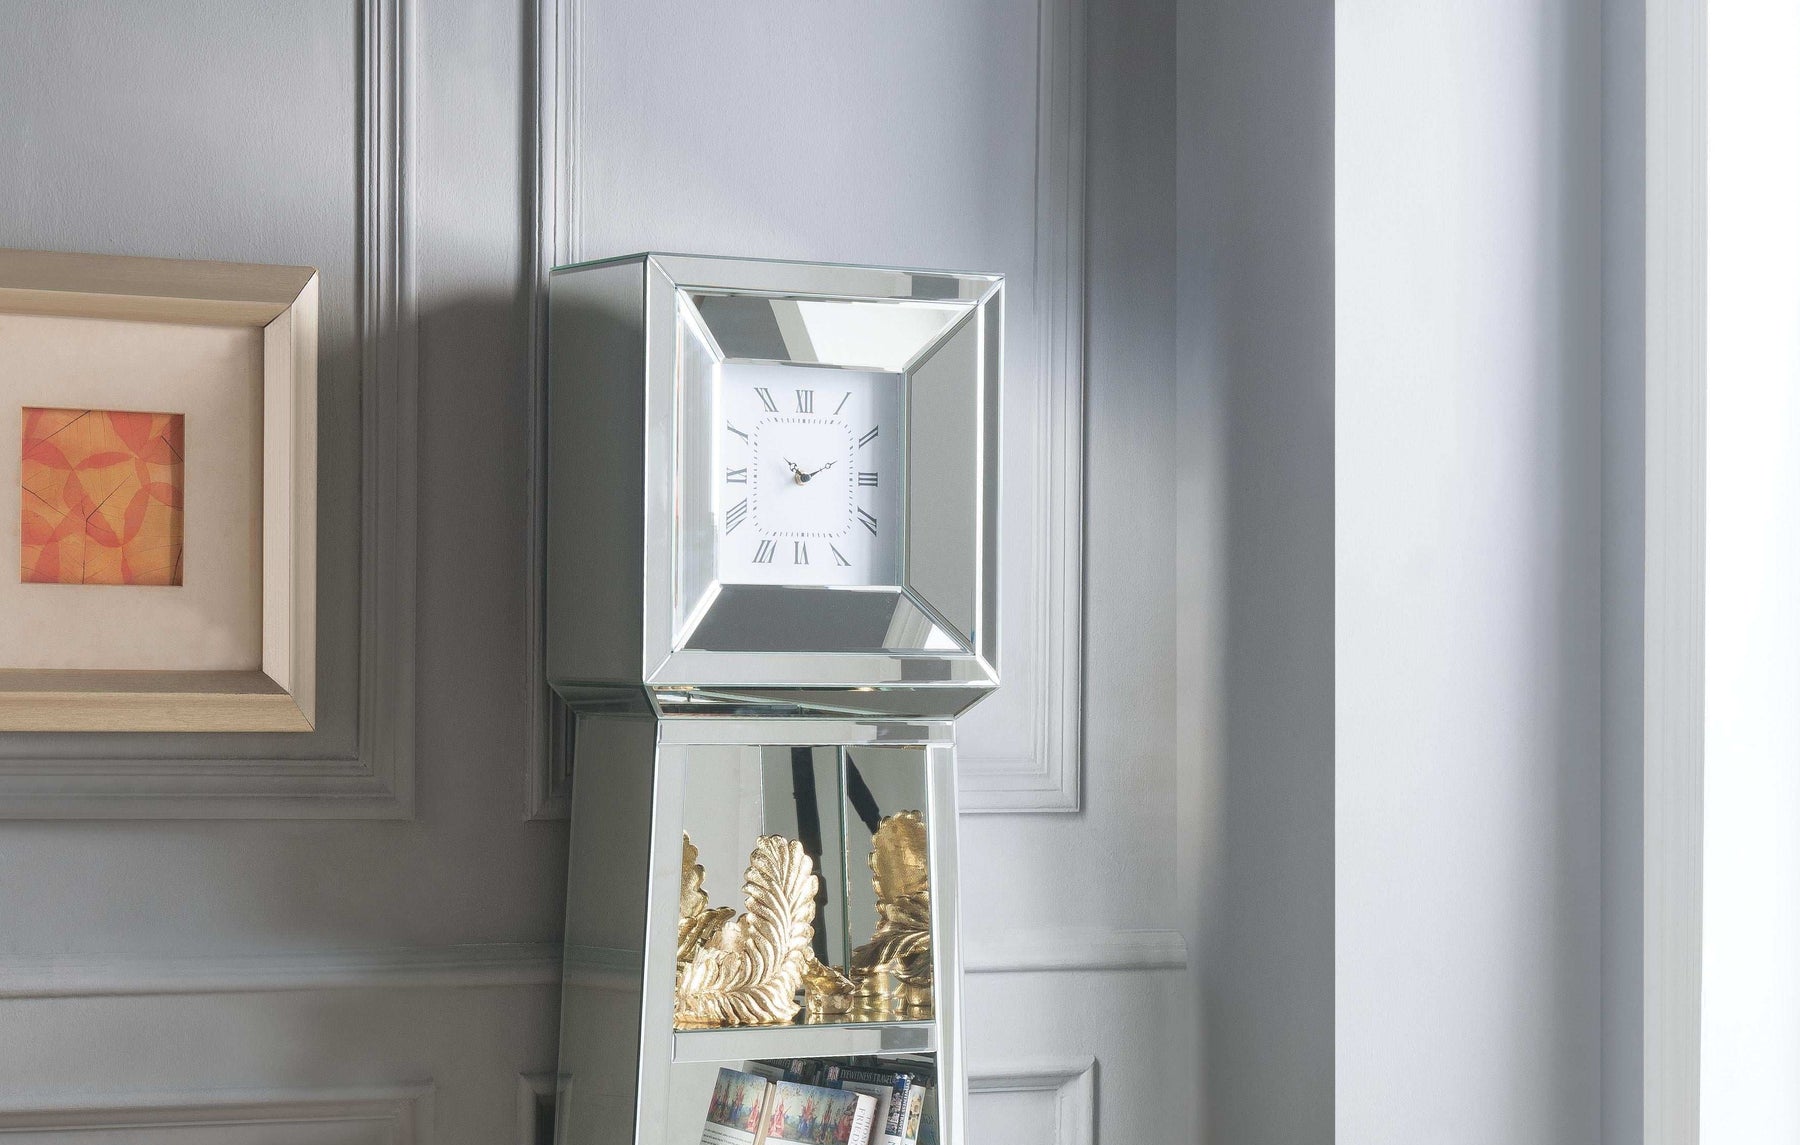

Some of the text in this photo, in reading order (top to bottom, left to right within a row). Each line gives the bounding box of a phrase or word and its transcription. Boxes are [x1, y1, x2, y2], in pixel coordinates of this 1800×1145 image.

[754, 387, 779, 413] XI
[795, 389, 814, 414] XII
[832, 391, 852, 415] I
[726, 419, 749, 445] X
[858, 424, 879, 449] II
[726, 467, 747, 484] IX
[858, 471, 879, 488] III
[725, 498, 748, 536] VIII
[752, 540, 778, 564] VII
[793, 541, 810, 565] VI
[829, 542, 852, 567] V
